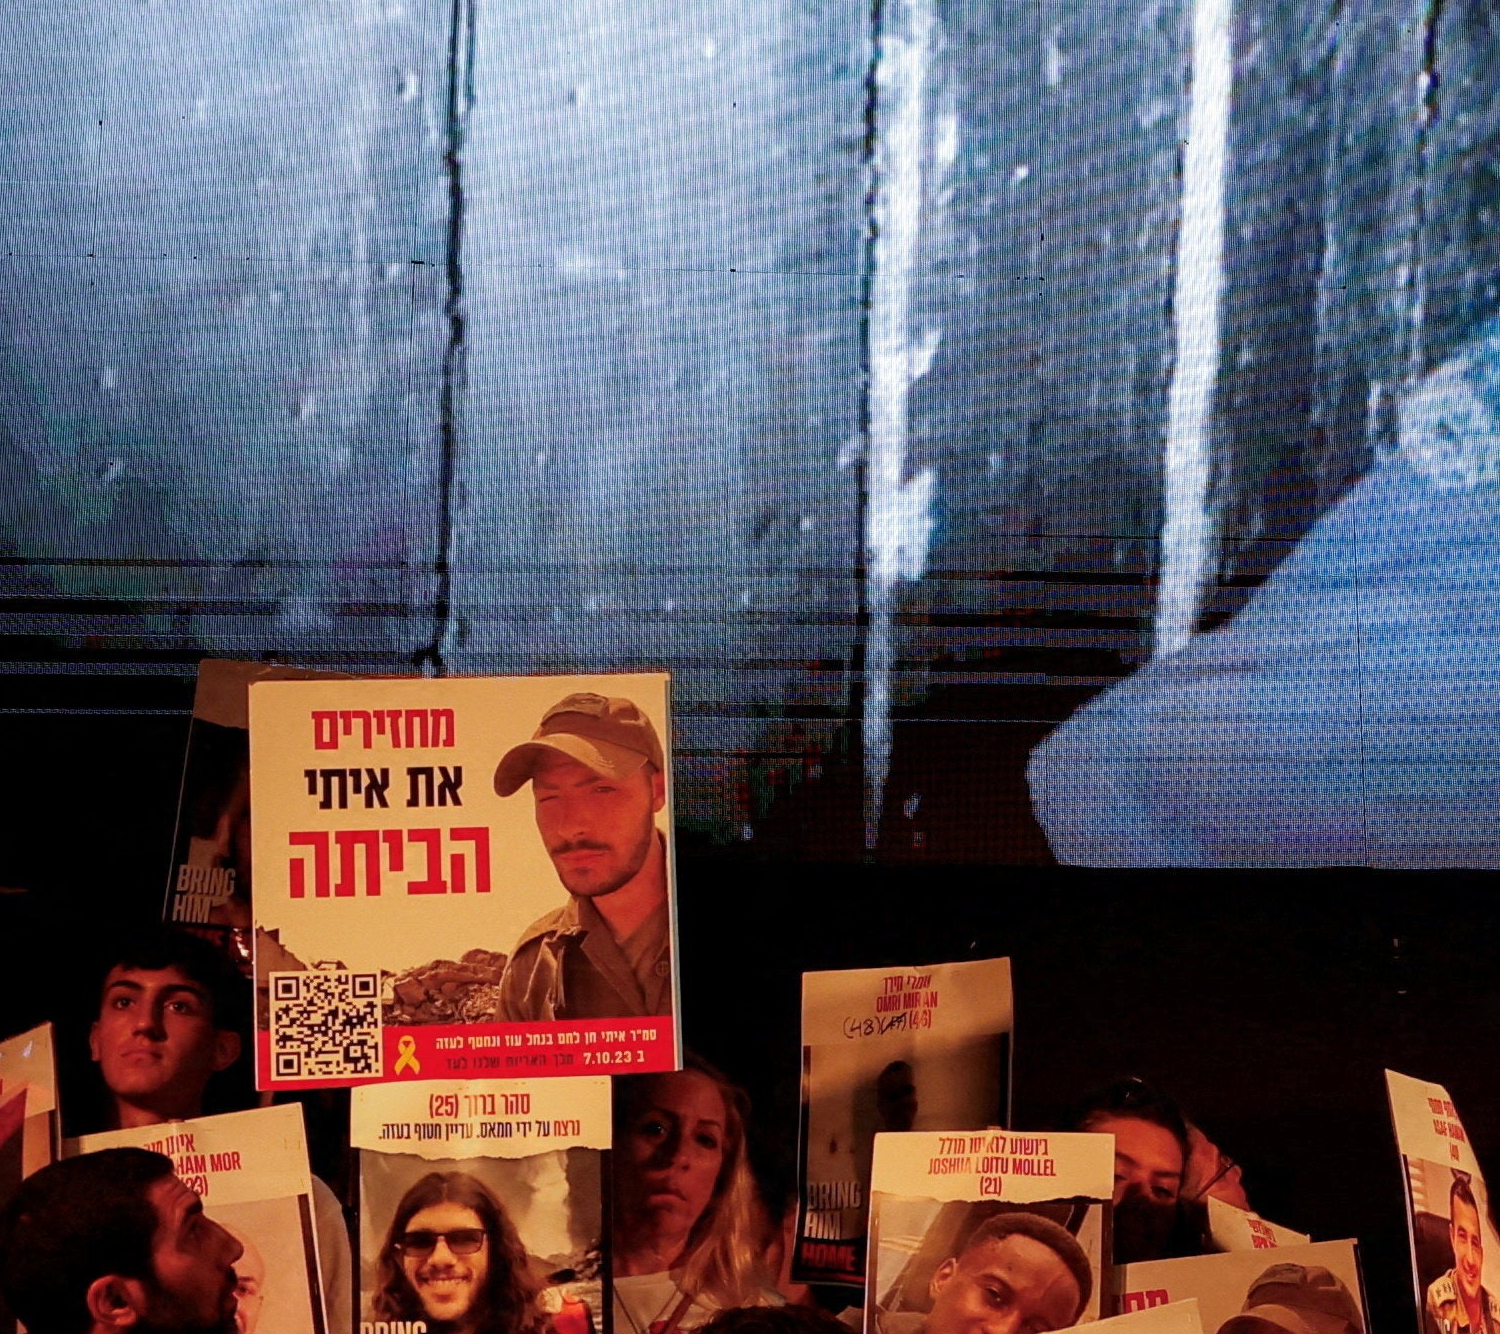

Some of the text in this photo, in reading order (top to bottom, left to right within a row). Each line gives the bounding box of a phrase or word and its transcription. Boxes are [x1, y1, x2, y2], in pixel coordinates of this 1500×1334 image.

[311, 706, 455, 751] מחזירים
[304, 766, 463, 810] את איתי
[288, 827, 491, 899] הביתה
[177, 864, 236, 896] BRING
[172, 894, 211, 923] HIM
[469, 1034, 501, 1049] ונחטף
[583, 1051, 632, 1065] 7.10.23
[429, 1093, 459, 1118] (25)
[378, 1122, 409, 1141] בעזה.
[476, 1124, 512, 1141] חמאס.
[210, 1153, 241, 1173] MOR
[975, 1157, 1008, 1176] LOITU
[1012, 1158, 1056, 1177] MOLLEL
